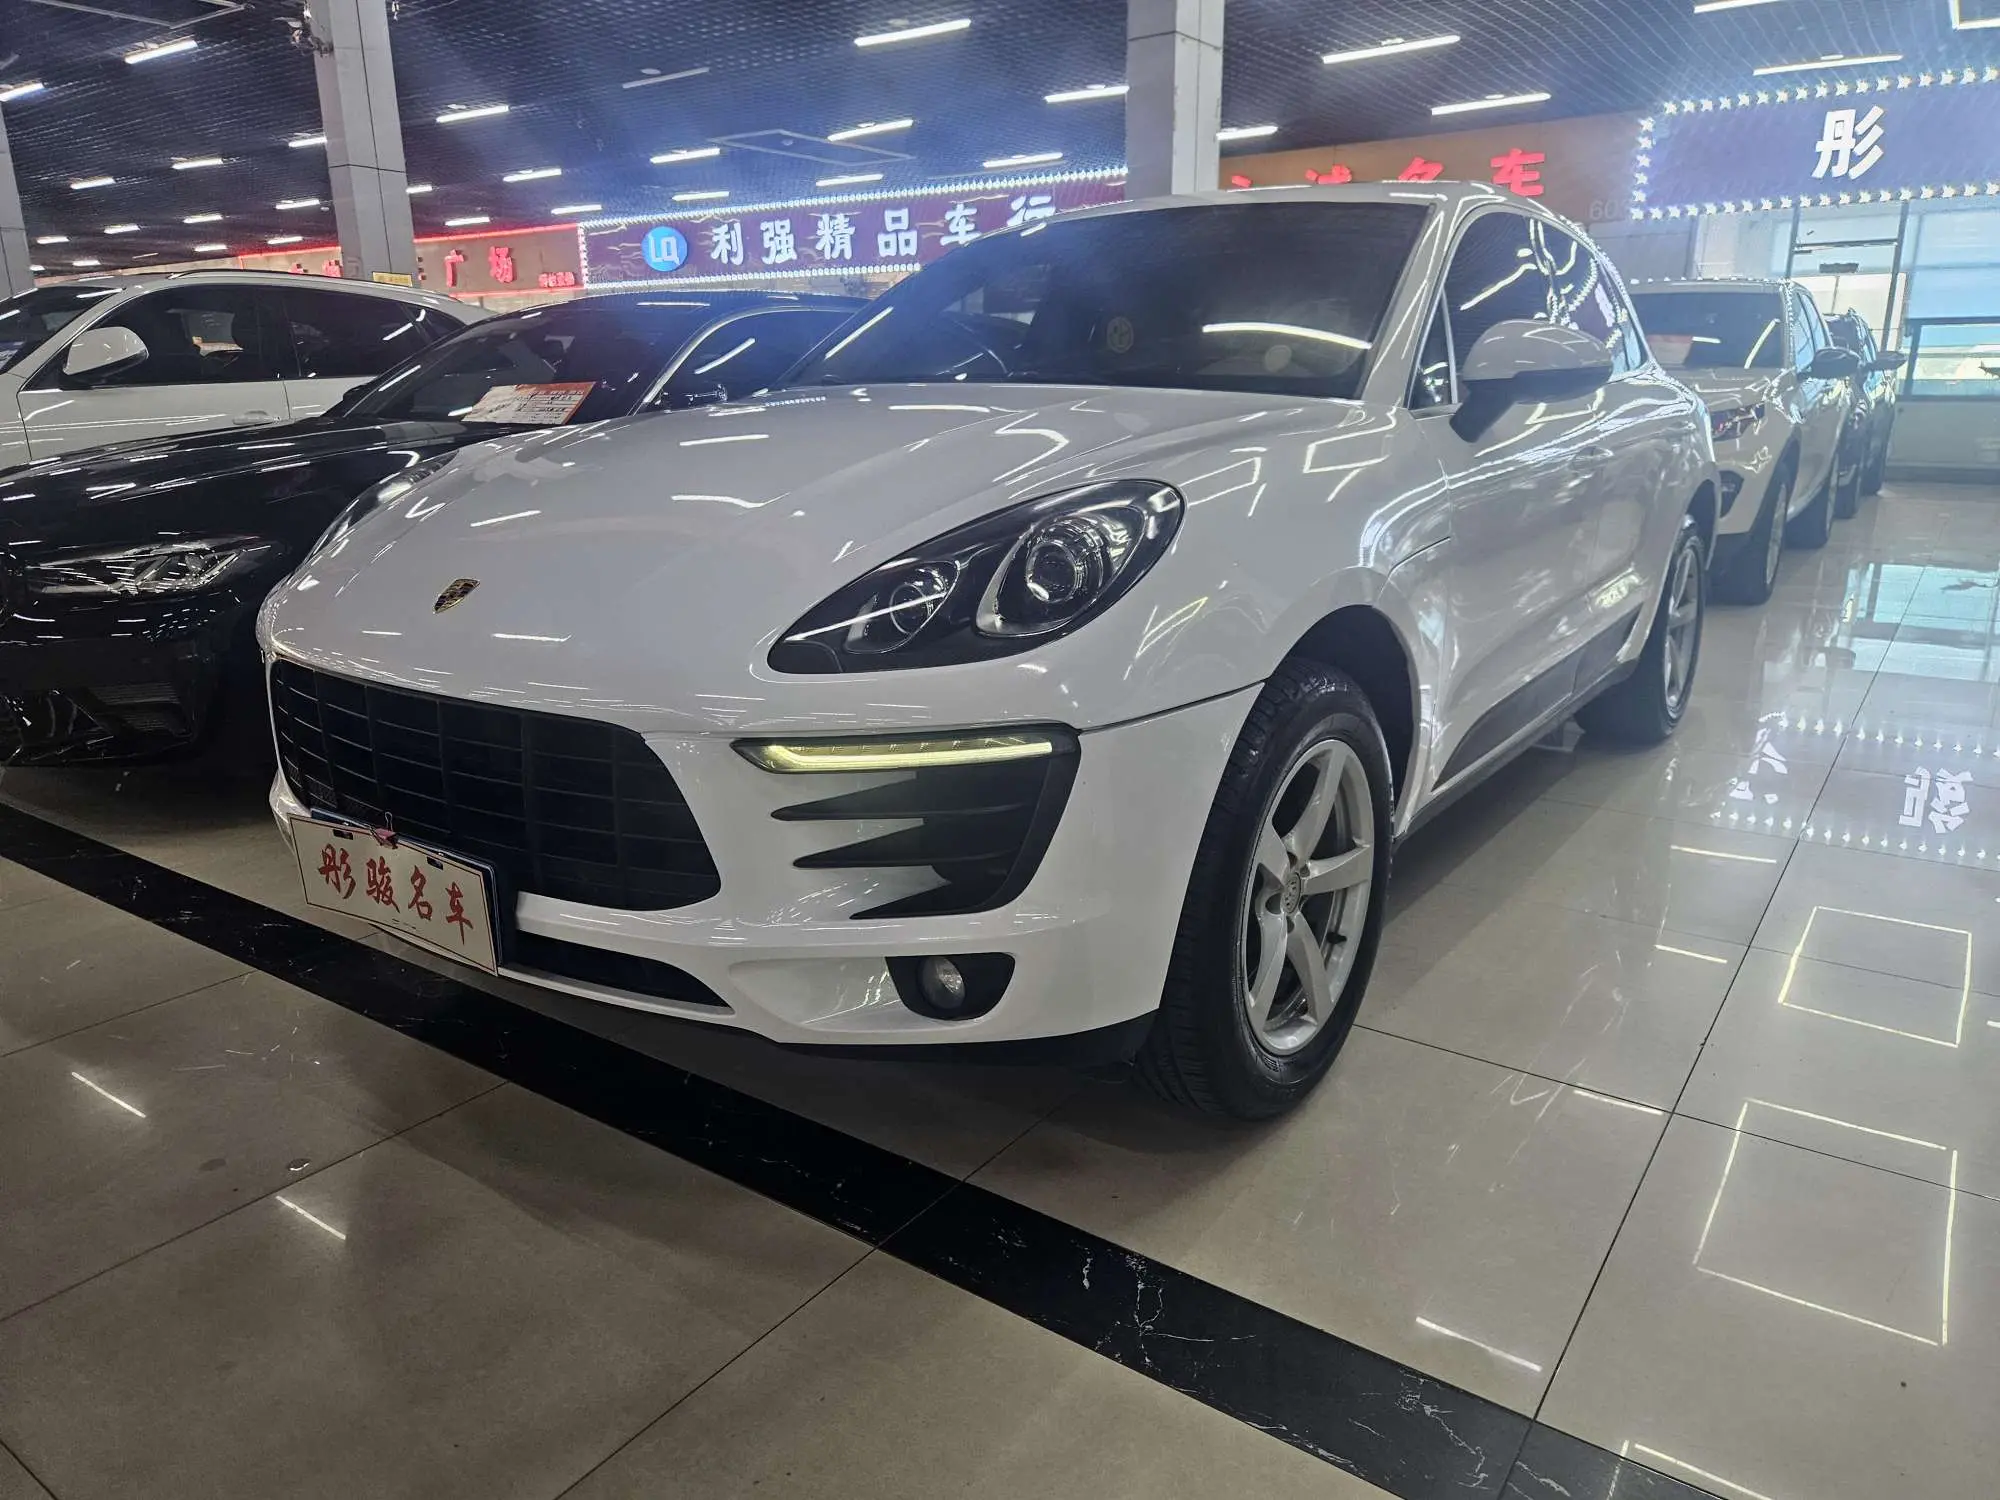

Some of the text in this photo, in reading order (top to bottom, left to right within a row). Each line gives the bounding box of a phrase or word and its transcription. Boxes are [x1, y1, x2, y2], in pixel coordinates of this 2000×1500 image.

[1812, 105, 1885, 180] 彤
[648, 195, 1055, 265] LQ 利强精品车行
[317, 843, 473, 945] 彤骏名车
